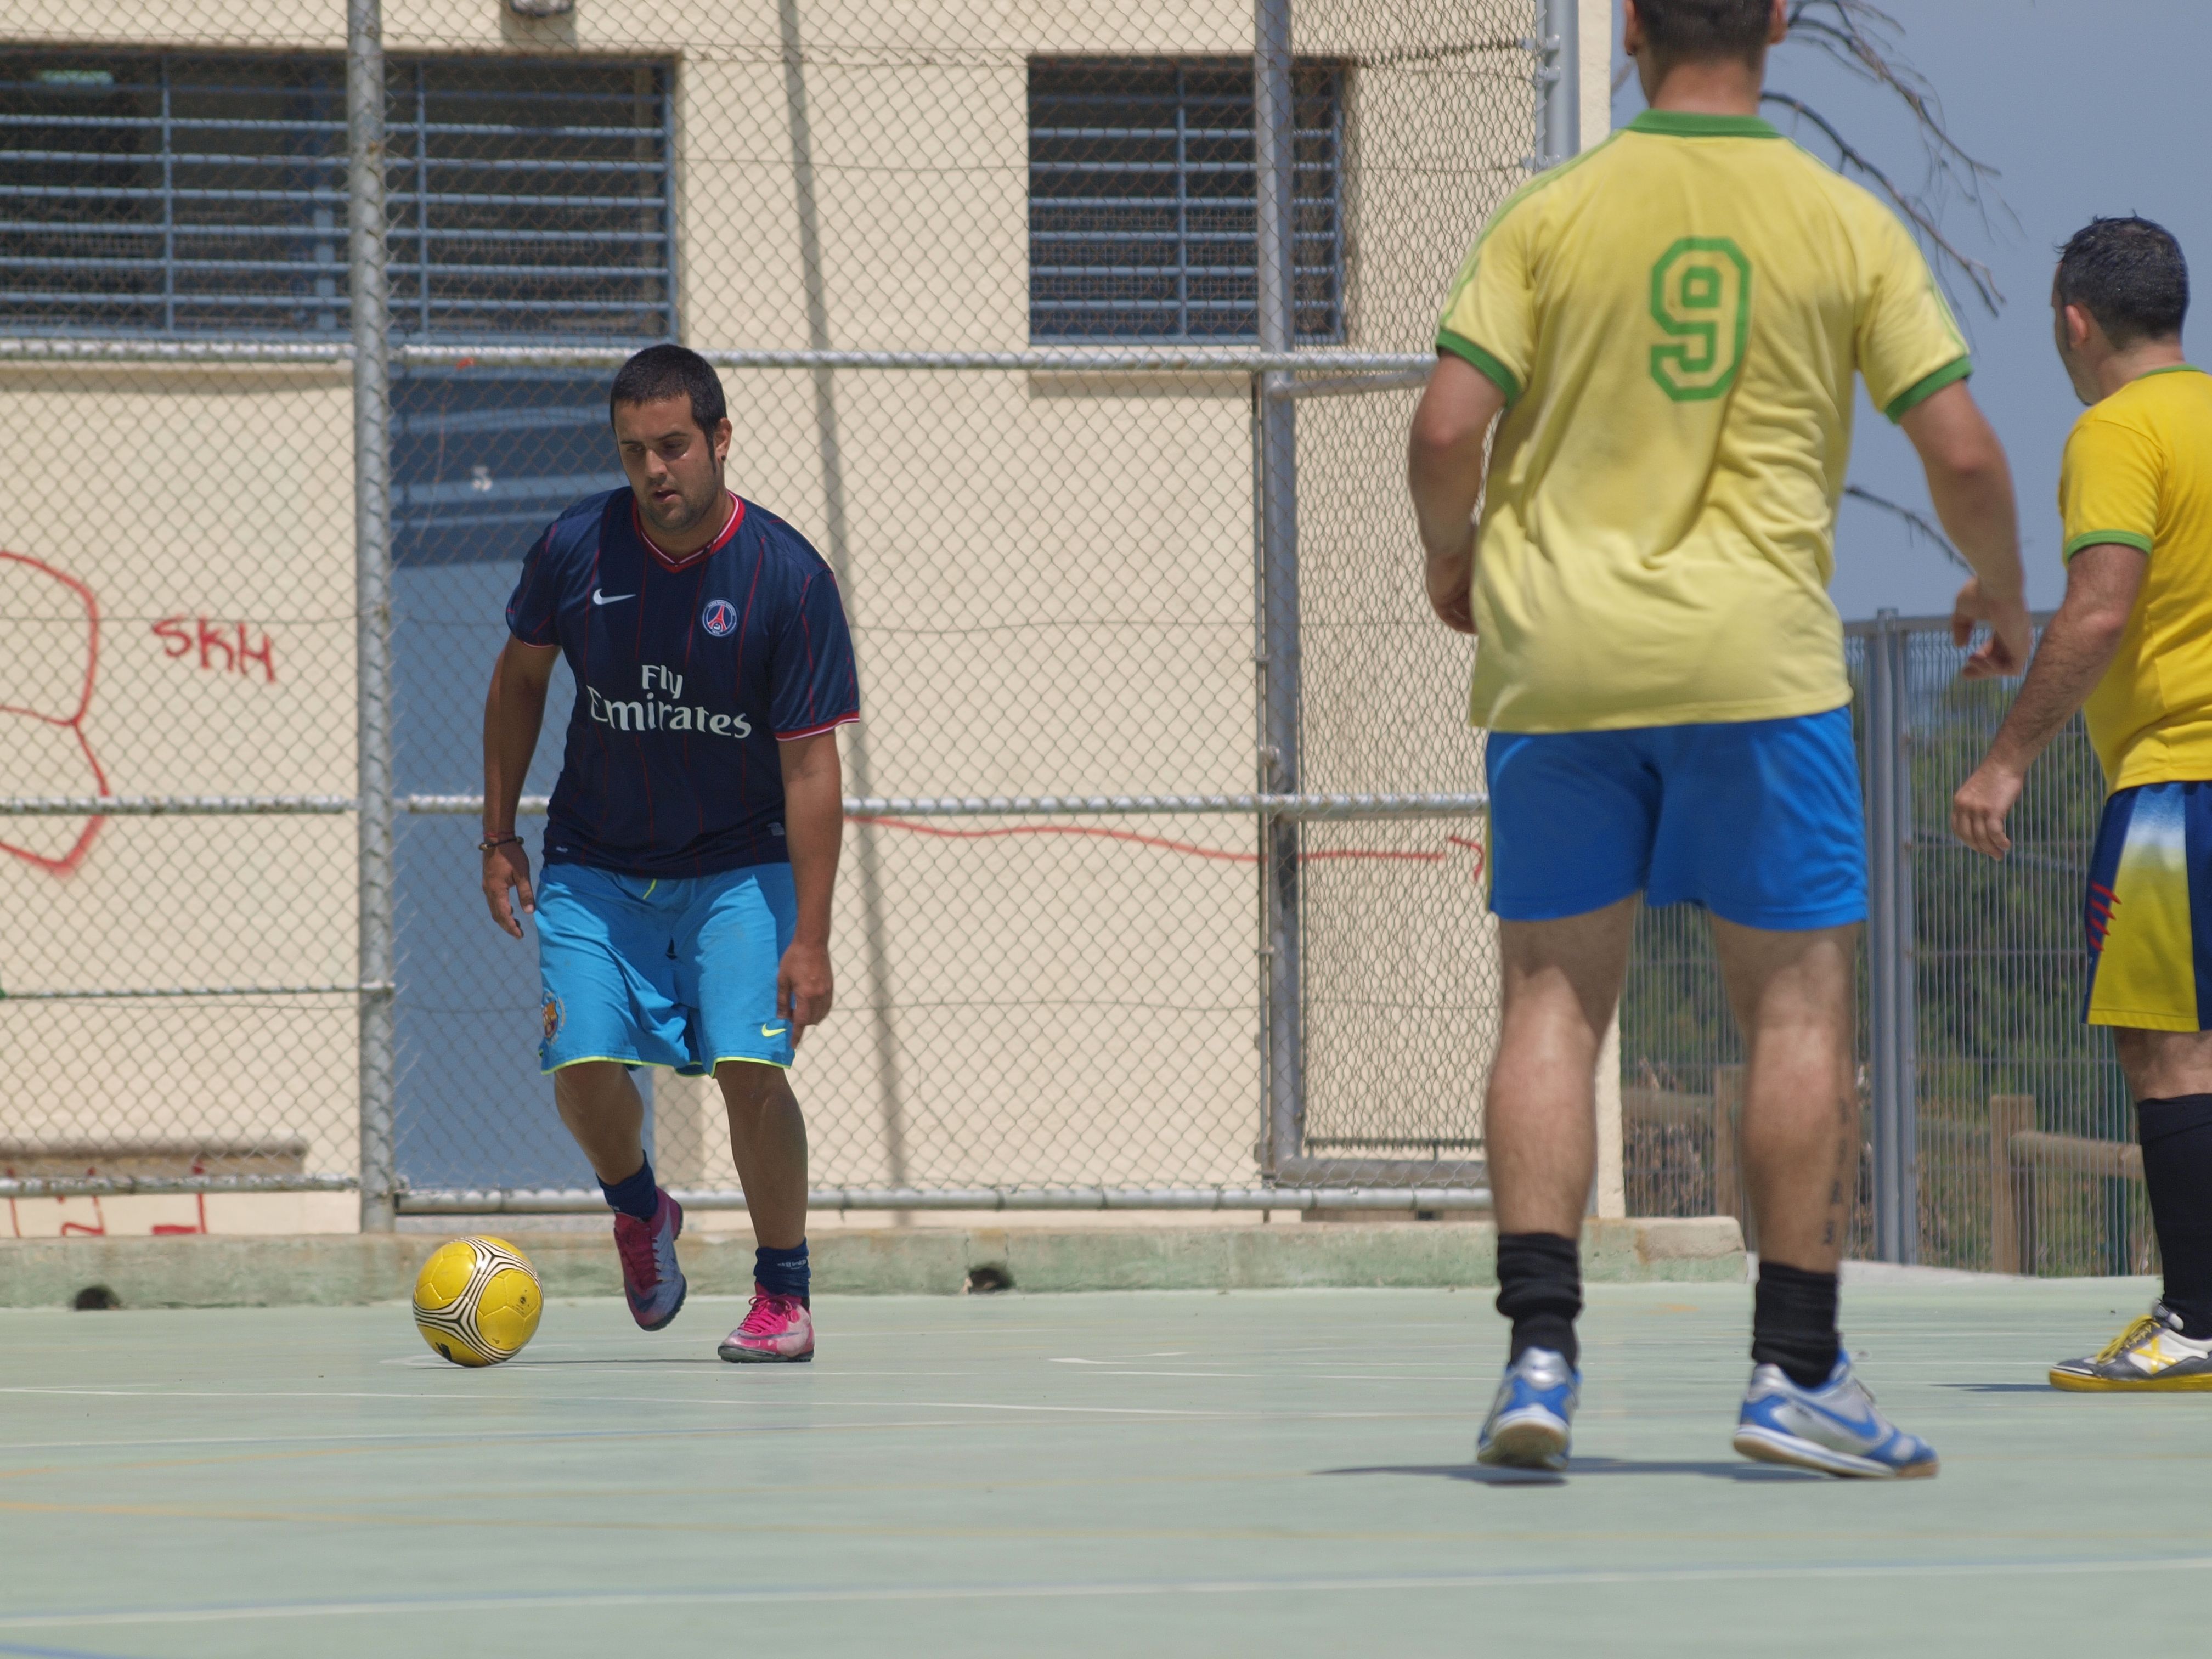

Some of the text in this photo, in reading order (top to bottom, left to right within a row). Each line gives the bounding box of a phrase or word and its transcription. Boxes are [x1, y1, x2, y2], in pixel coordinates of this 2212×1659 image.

[1651, 237, 1752, 402] 9
[641, 664, 684, 699] Fly
[586, 684, 752, 739] Emirates
